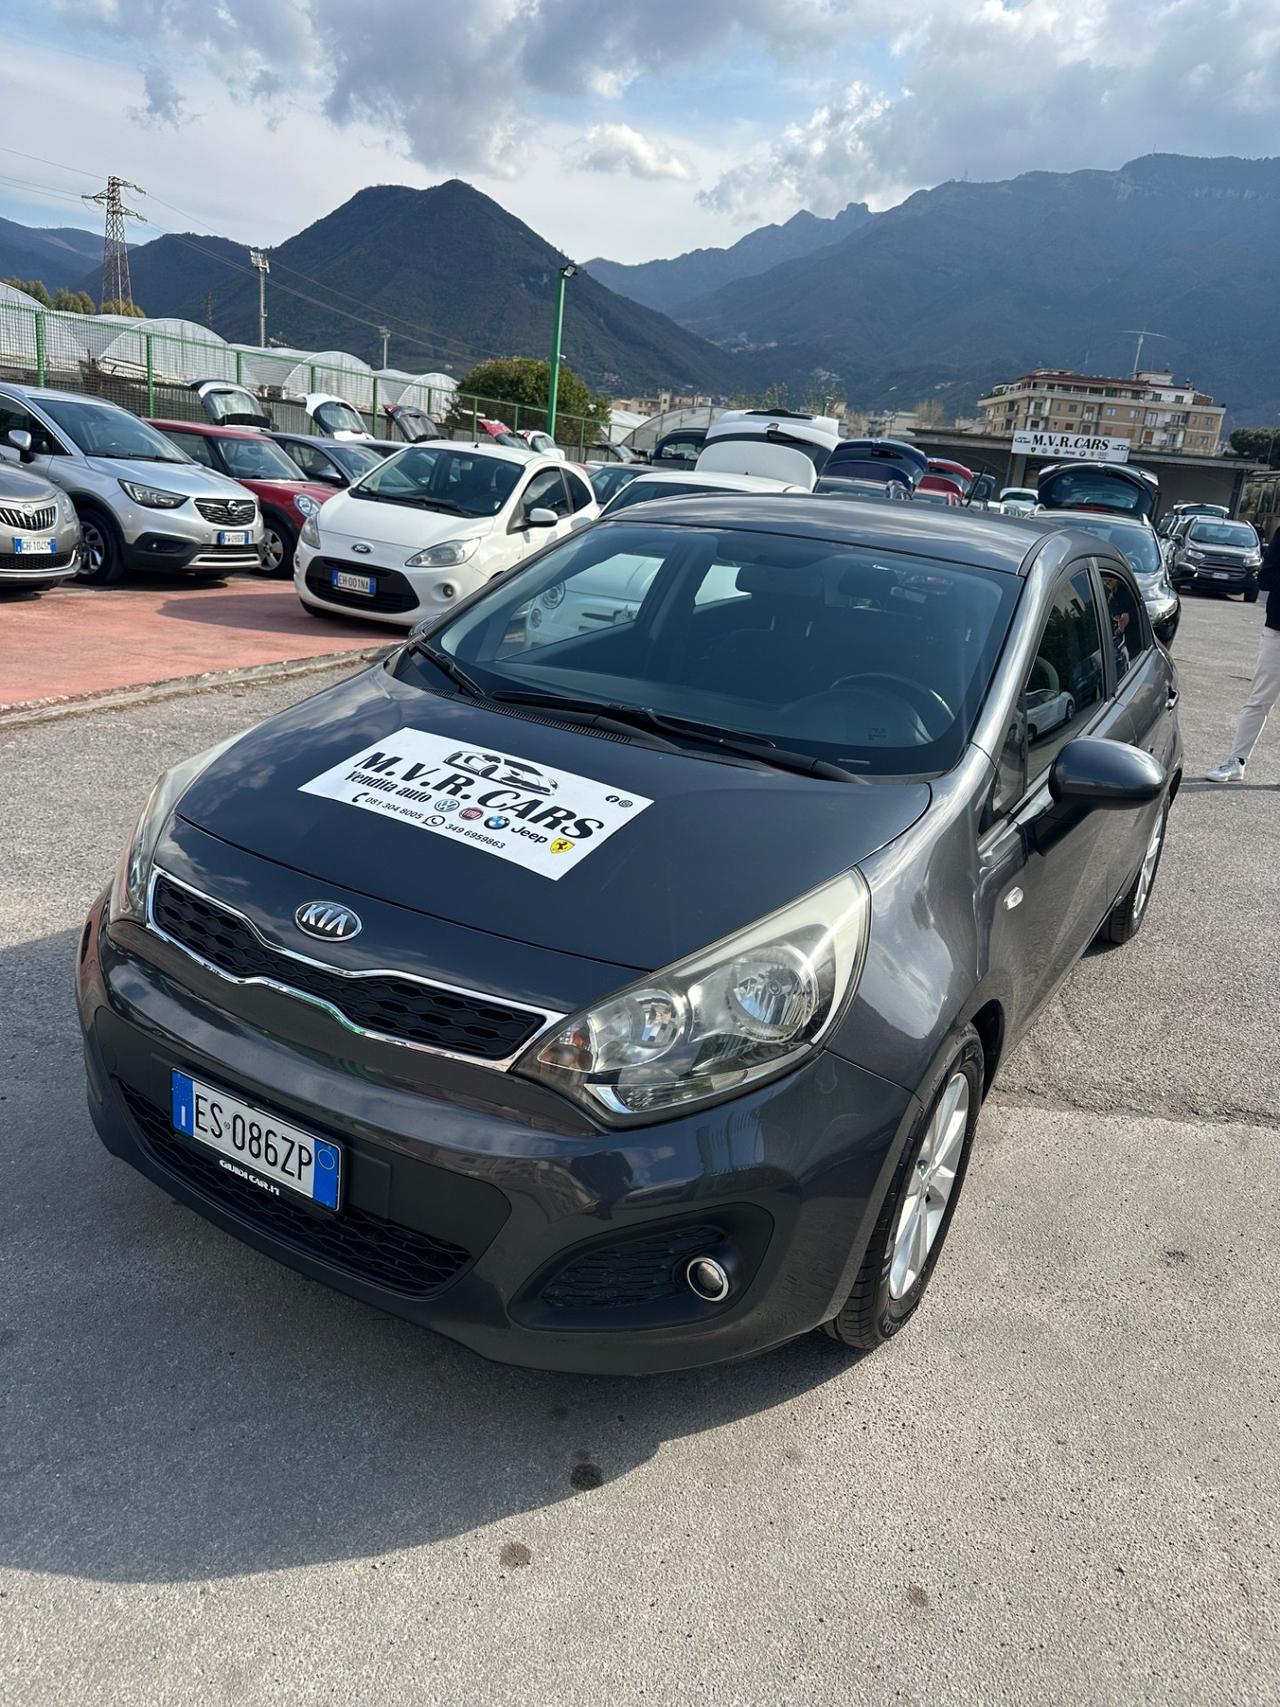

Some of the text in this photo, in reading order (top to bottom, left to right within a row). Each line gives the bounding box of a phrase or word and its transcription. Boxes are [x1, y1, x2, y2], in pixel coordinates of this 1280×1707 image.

[1032, 434, 1110, 451] M.V.R.CARS
[344, 770, 433, 803] Vendita auto
[364, 796, 425, 820] 081 304 8005
[445, 823, 506, 849] 349 6959863
[511, 826, 548, 844] Jeep
[301, 904, 348, 936] KIA
